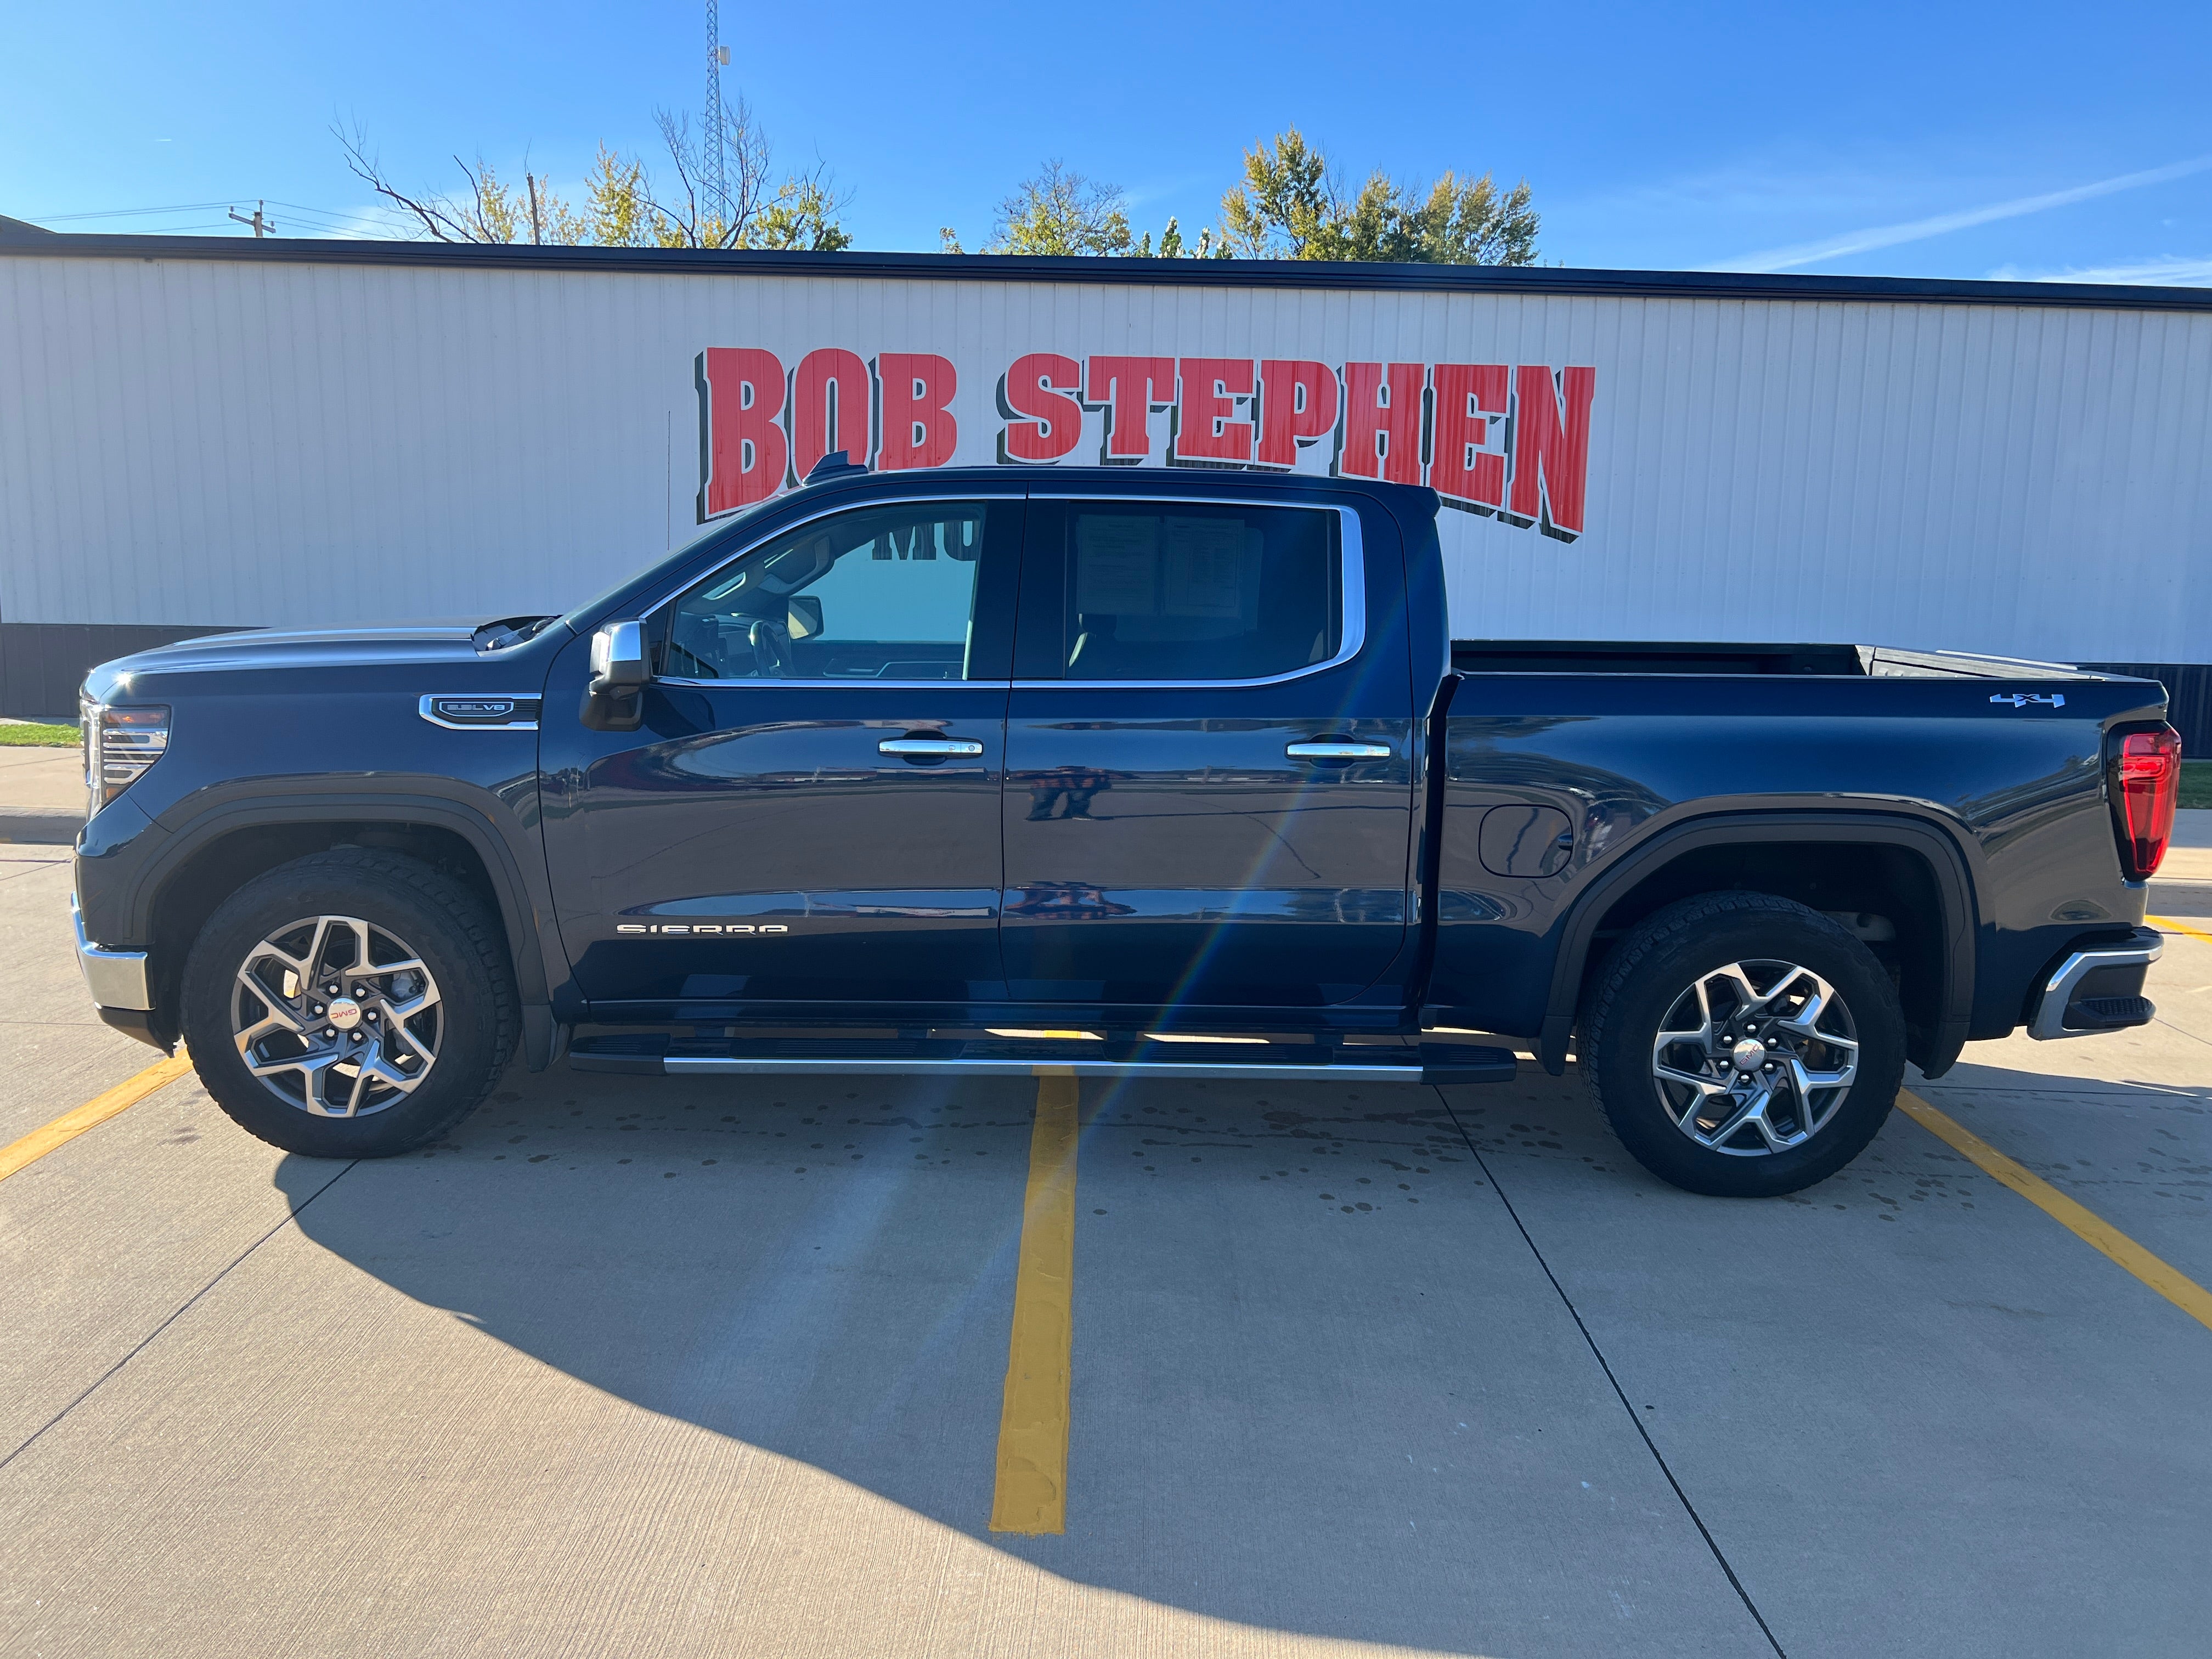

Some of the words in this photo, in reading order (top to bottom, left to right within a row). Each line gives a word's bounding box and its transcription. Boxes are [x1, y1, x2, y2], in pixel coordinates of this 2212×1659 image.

[694, 346, 958, 525] BOB
[996, 351, 1595, 544] STEPHEN
[617, 924, 788, 935] SIERRA
[330, 1008, 357, 1019] GMC
[1740, 1044, 1760, 1065] GMC
